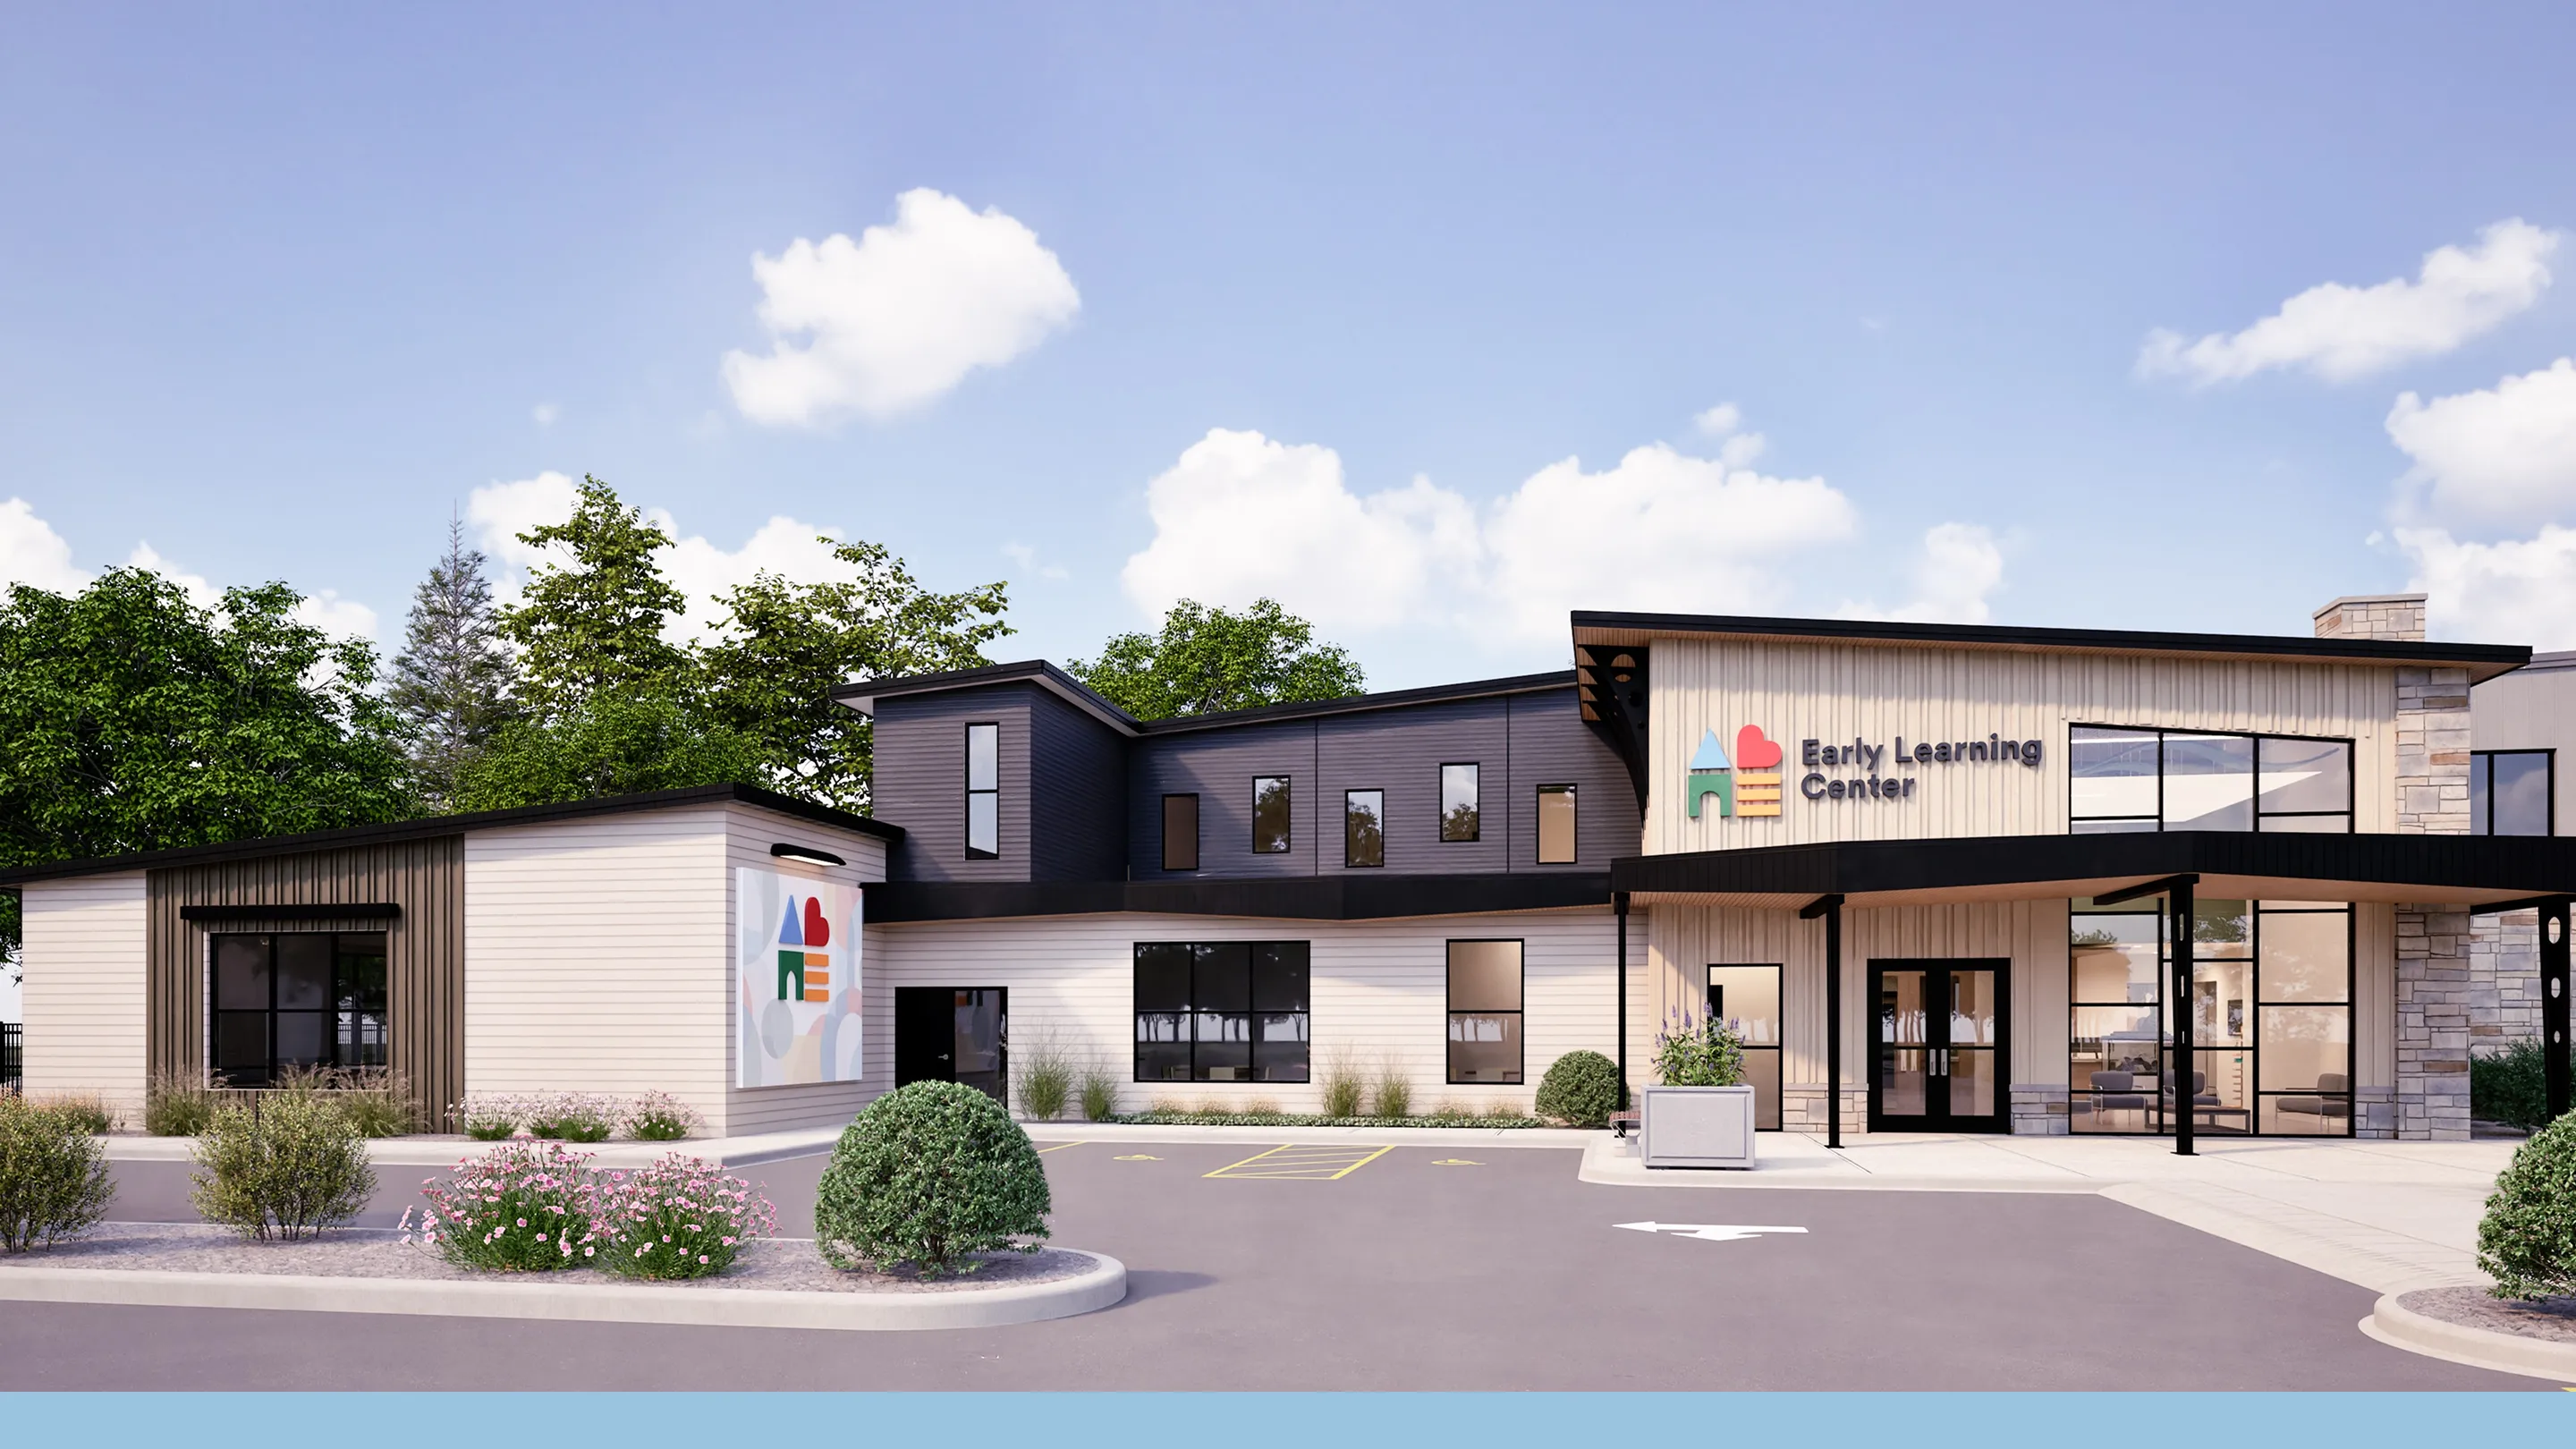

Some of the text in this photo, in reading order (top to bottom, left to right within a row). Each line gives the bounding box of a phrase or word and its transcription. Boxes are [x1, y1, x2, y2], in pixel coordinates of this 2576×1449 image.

[1801, 733, 2042, 770] Early Learning
[1801, 773, 1915, 800] Center
